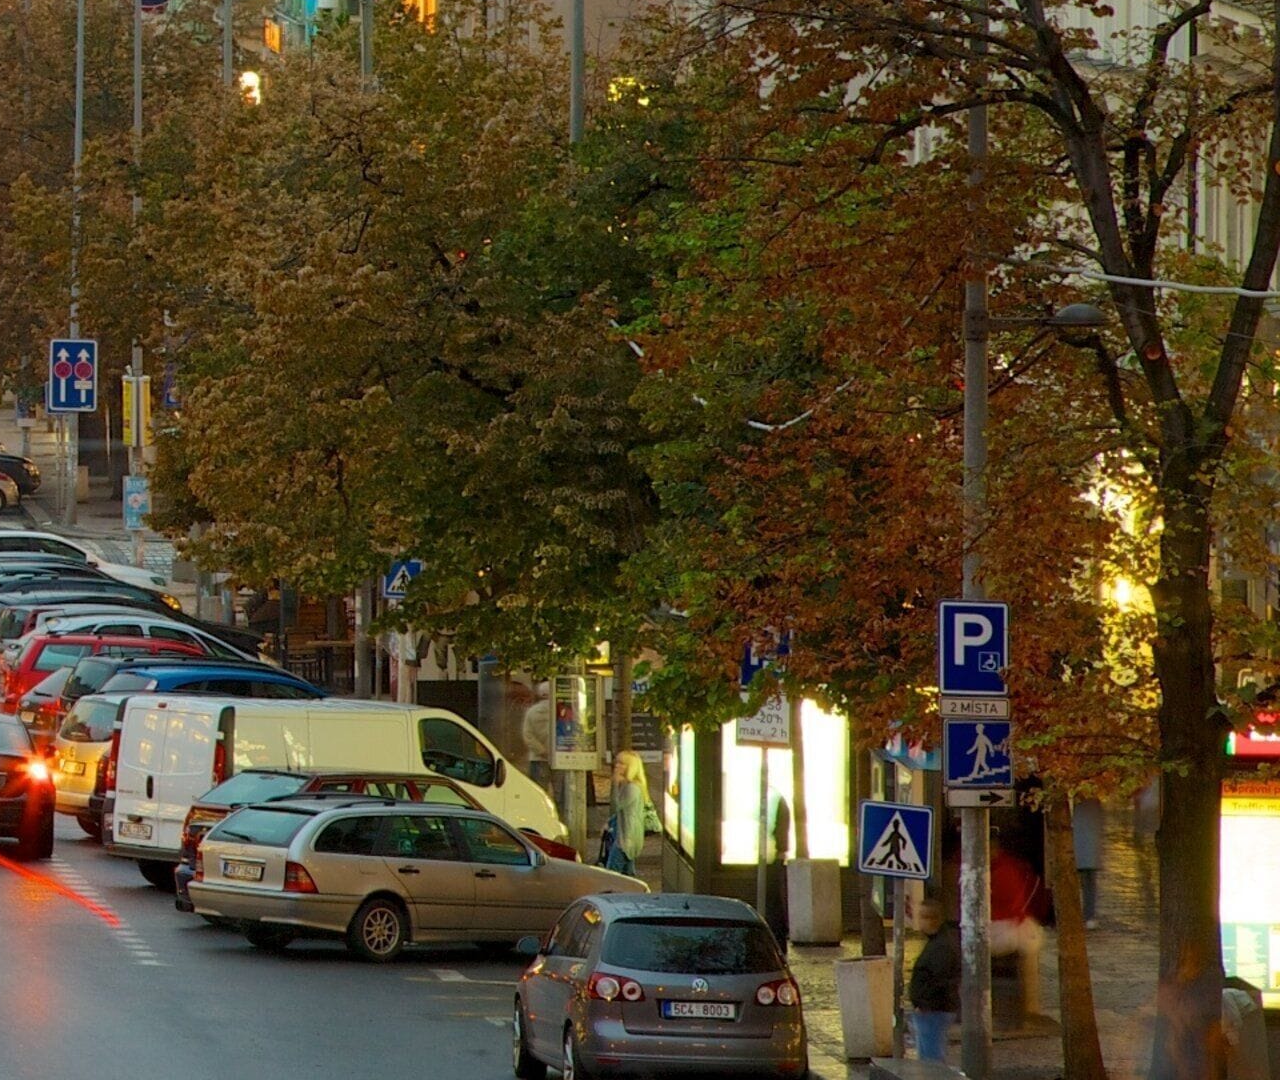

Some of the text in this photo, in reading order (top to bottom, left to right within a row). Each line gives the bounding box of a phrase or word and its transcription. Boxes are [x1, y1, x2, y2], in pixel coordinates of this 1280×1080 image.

[954, 613, 993, 666] P
[950, 700, 998, 714] 2 MÍSTA
[771, 727, 778, 737] 2
[781, 726, 788, 737] h
[674, 1003, 729, 1016] 5C4 8003
